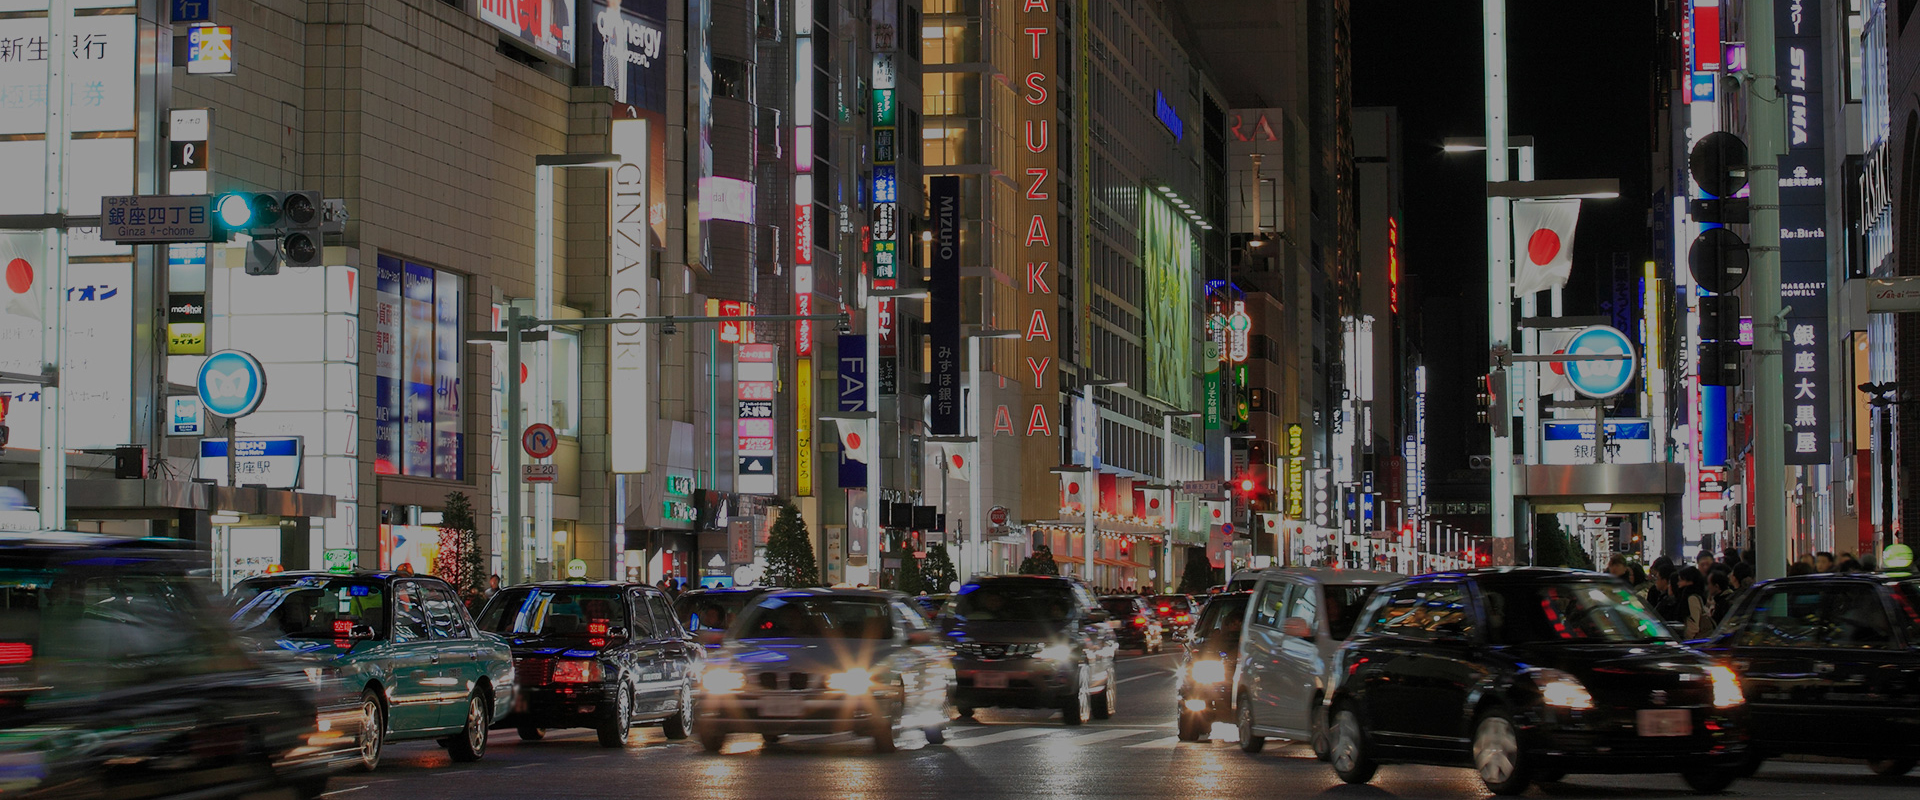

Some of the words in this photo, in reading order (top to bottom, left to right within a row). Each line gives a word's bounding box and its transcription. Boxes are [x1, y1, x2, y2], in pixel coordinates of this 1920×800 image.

[1790, 0, 1802, 34] ラリー
[0, 35, 108, 62] 新生行
[0, 81, 105, 108] 極東券
[1789, 46, 1807, 145] SHIMA
[108, 206, 204, 225] 銀座四丁目
[109, 198, 139, 206] 中央区
[616, 162, 642, 275] GINZA
[118, 227, 146, 236] Ginza
[150, 227, 195, 236] 4-chome
[940, 195, 955, 260] MIZUHO
[1780, 228, 1825, 239] Re:Birth
[937, 346, 952, 416] みずほ銀行
[1793, 324, 1818, 453] 銀座大黒屋
[1207, 382, 1217, 423] りそな銀行
